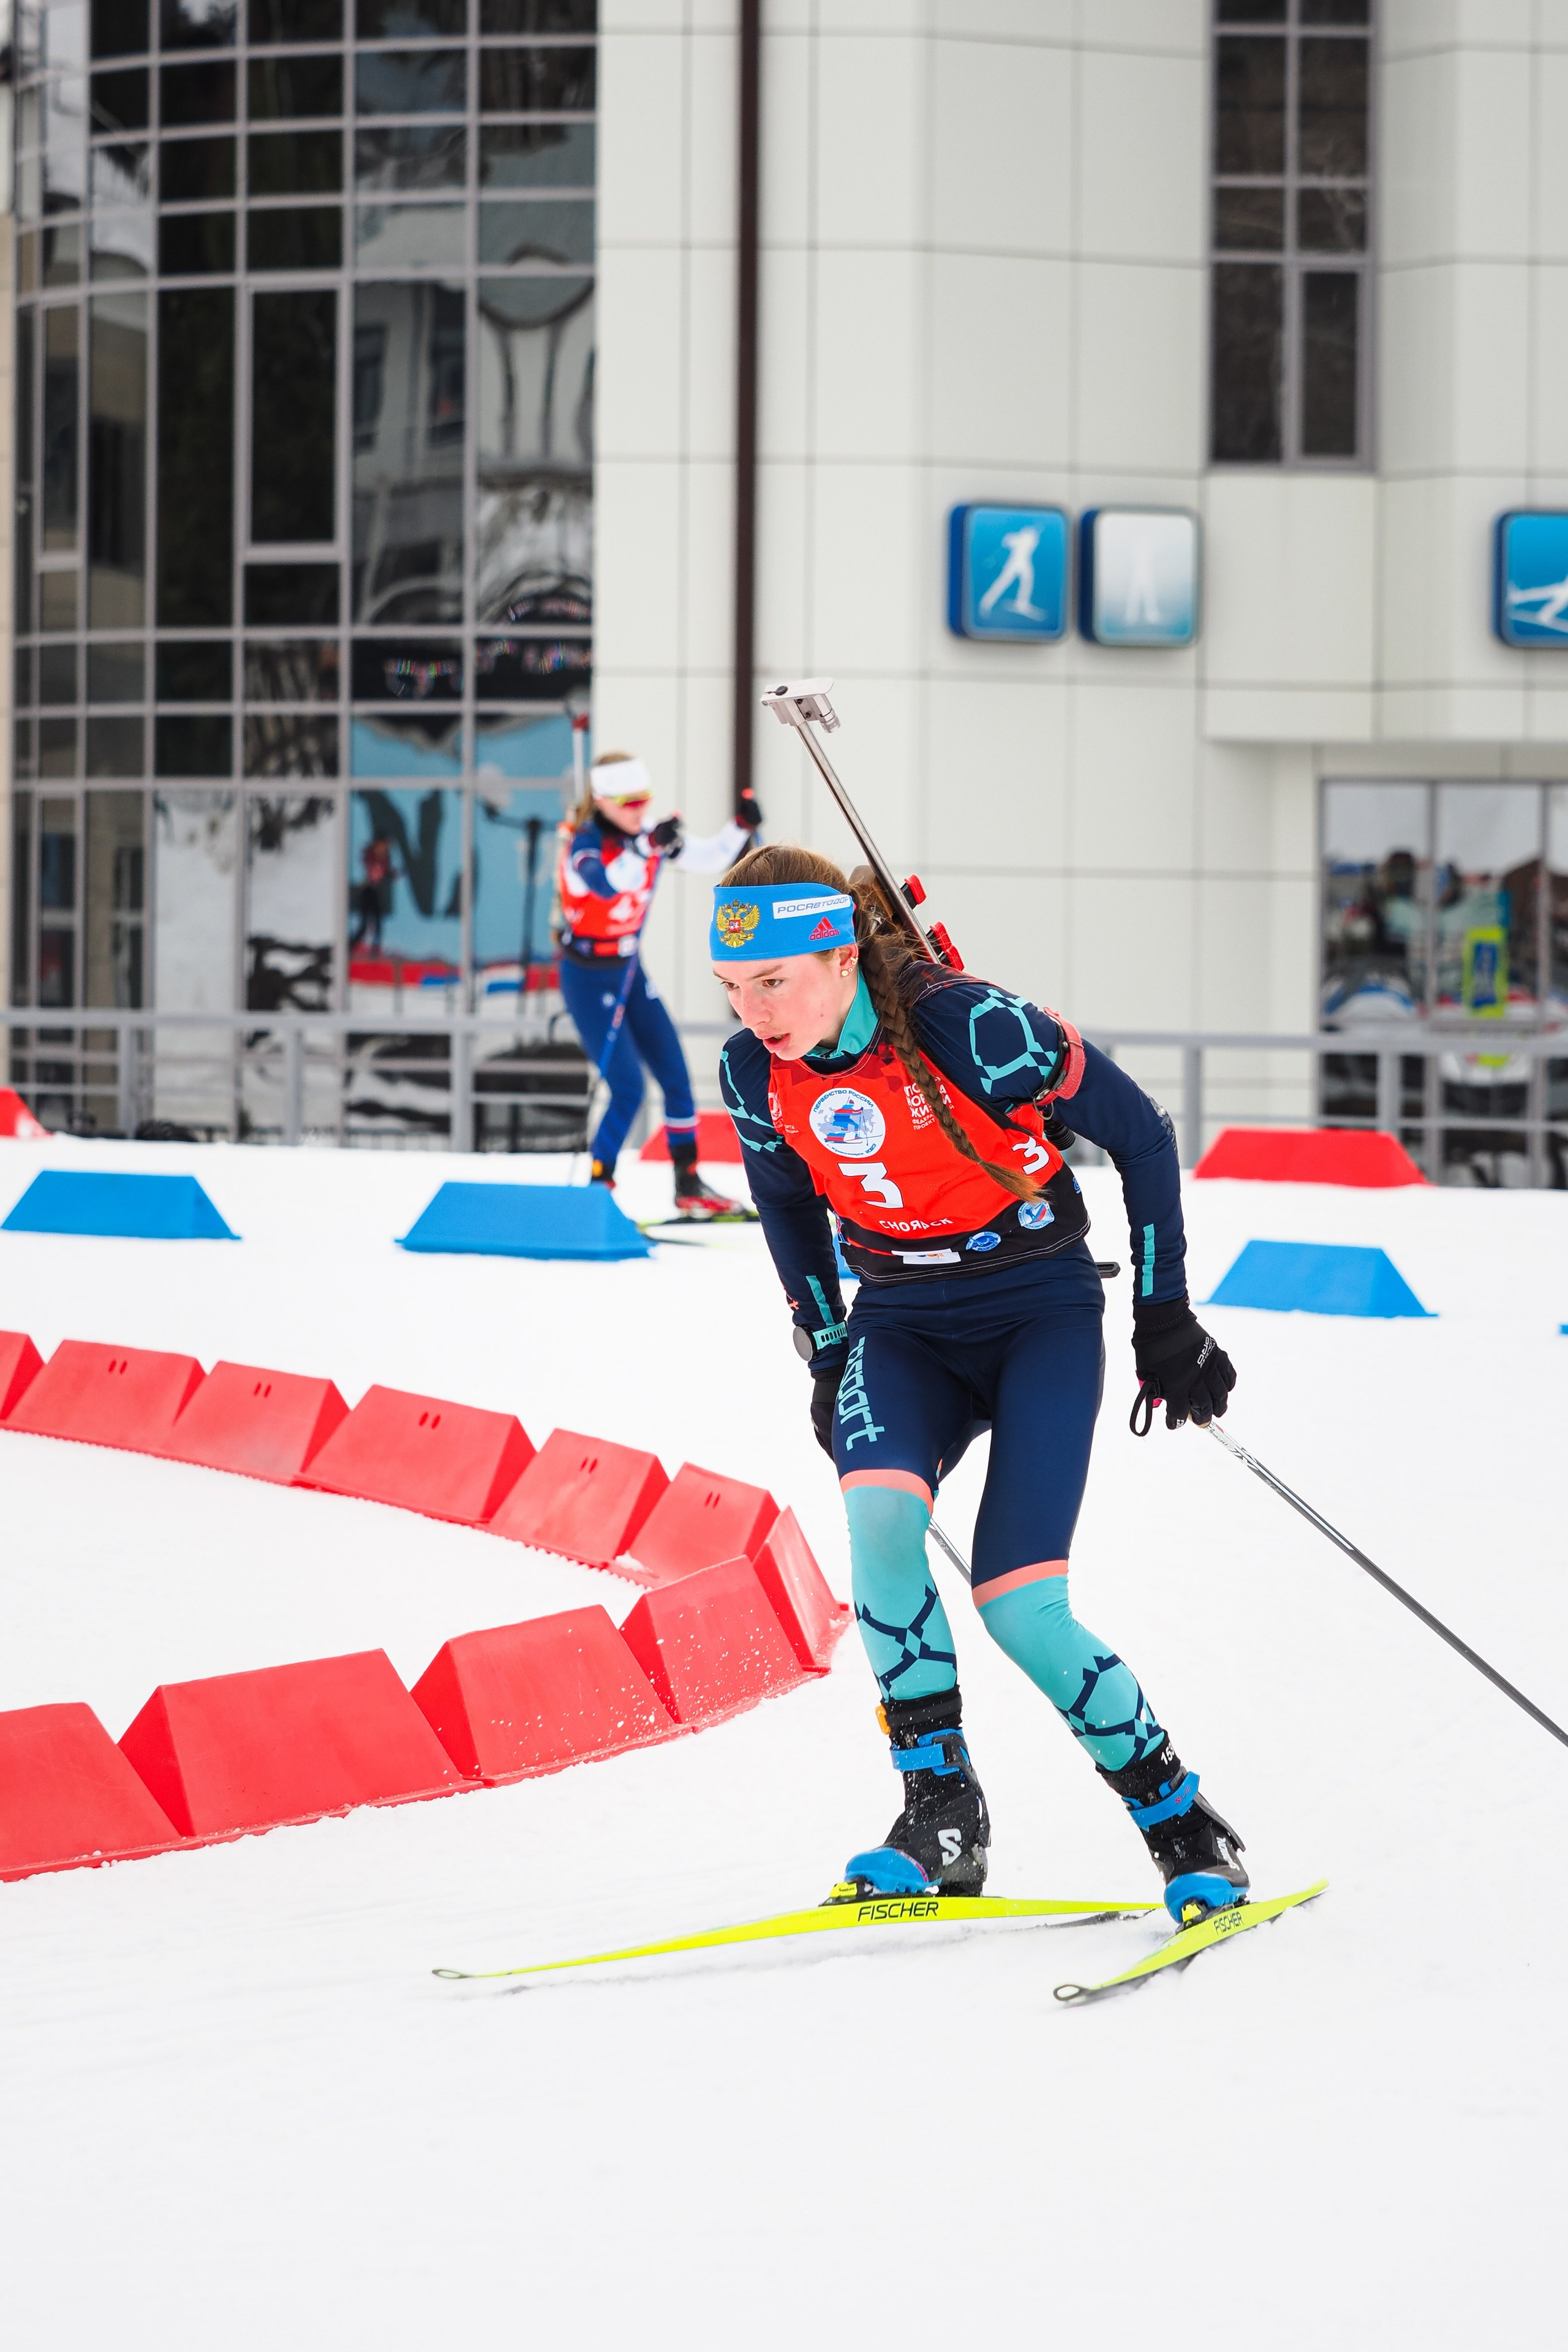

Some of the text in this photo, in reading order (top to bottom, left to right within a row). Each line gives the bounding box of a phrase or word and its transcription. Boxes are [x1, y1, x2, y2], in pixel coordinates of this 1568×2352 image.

[809, 928, 840, 941] adidas
[813, 1090, 874, 1112] ПЕРВЕНСТВО РОССИИ
[913, 1118, 935, 1130] ПРОЕКТ
[1012, 1136, 1050, 1175] 3
[837, 1162, 903, 1208] 3
[858, 1901, 939, 1922] FISCHER
[1213, 1911, 1245, 1936] FISCHER
